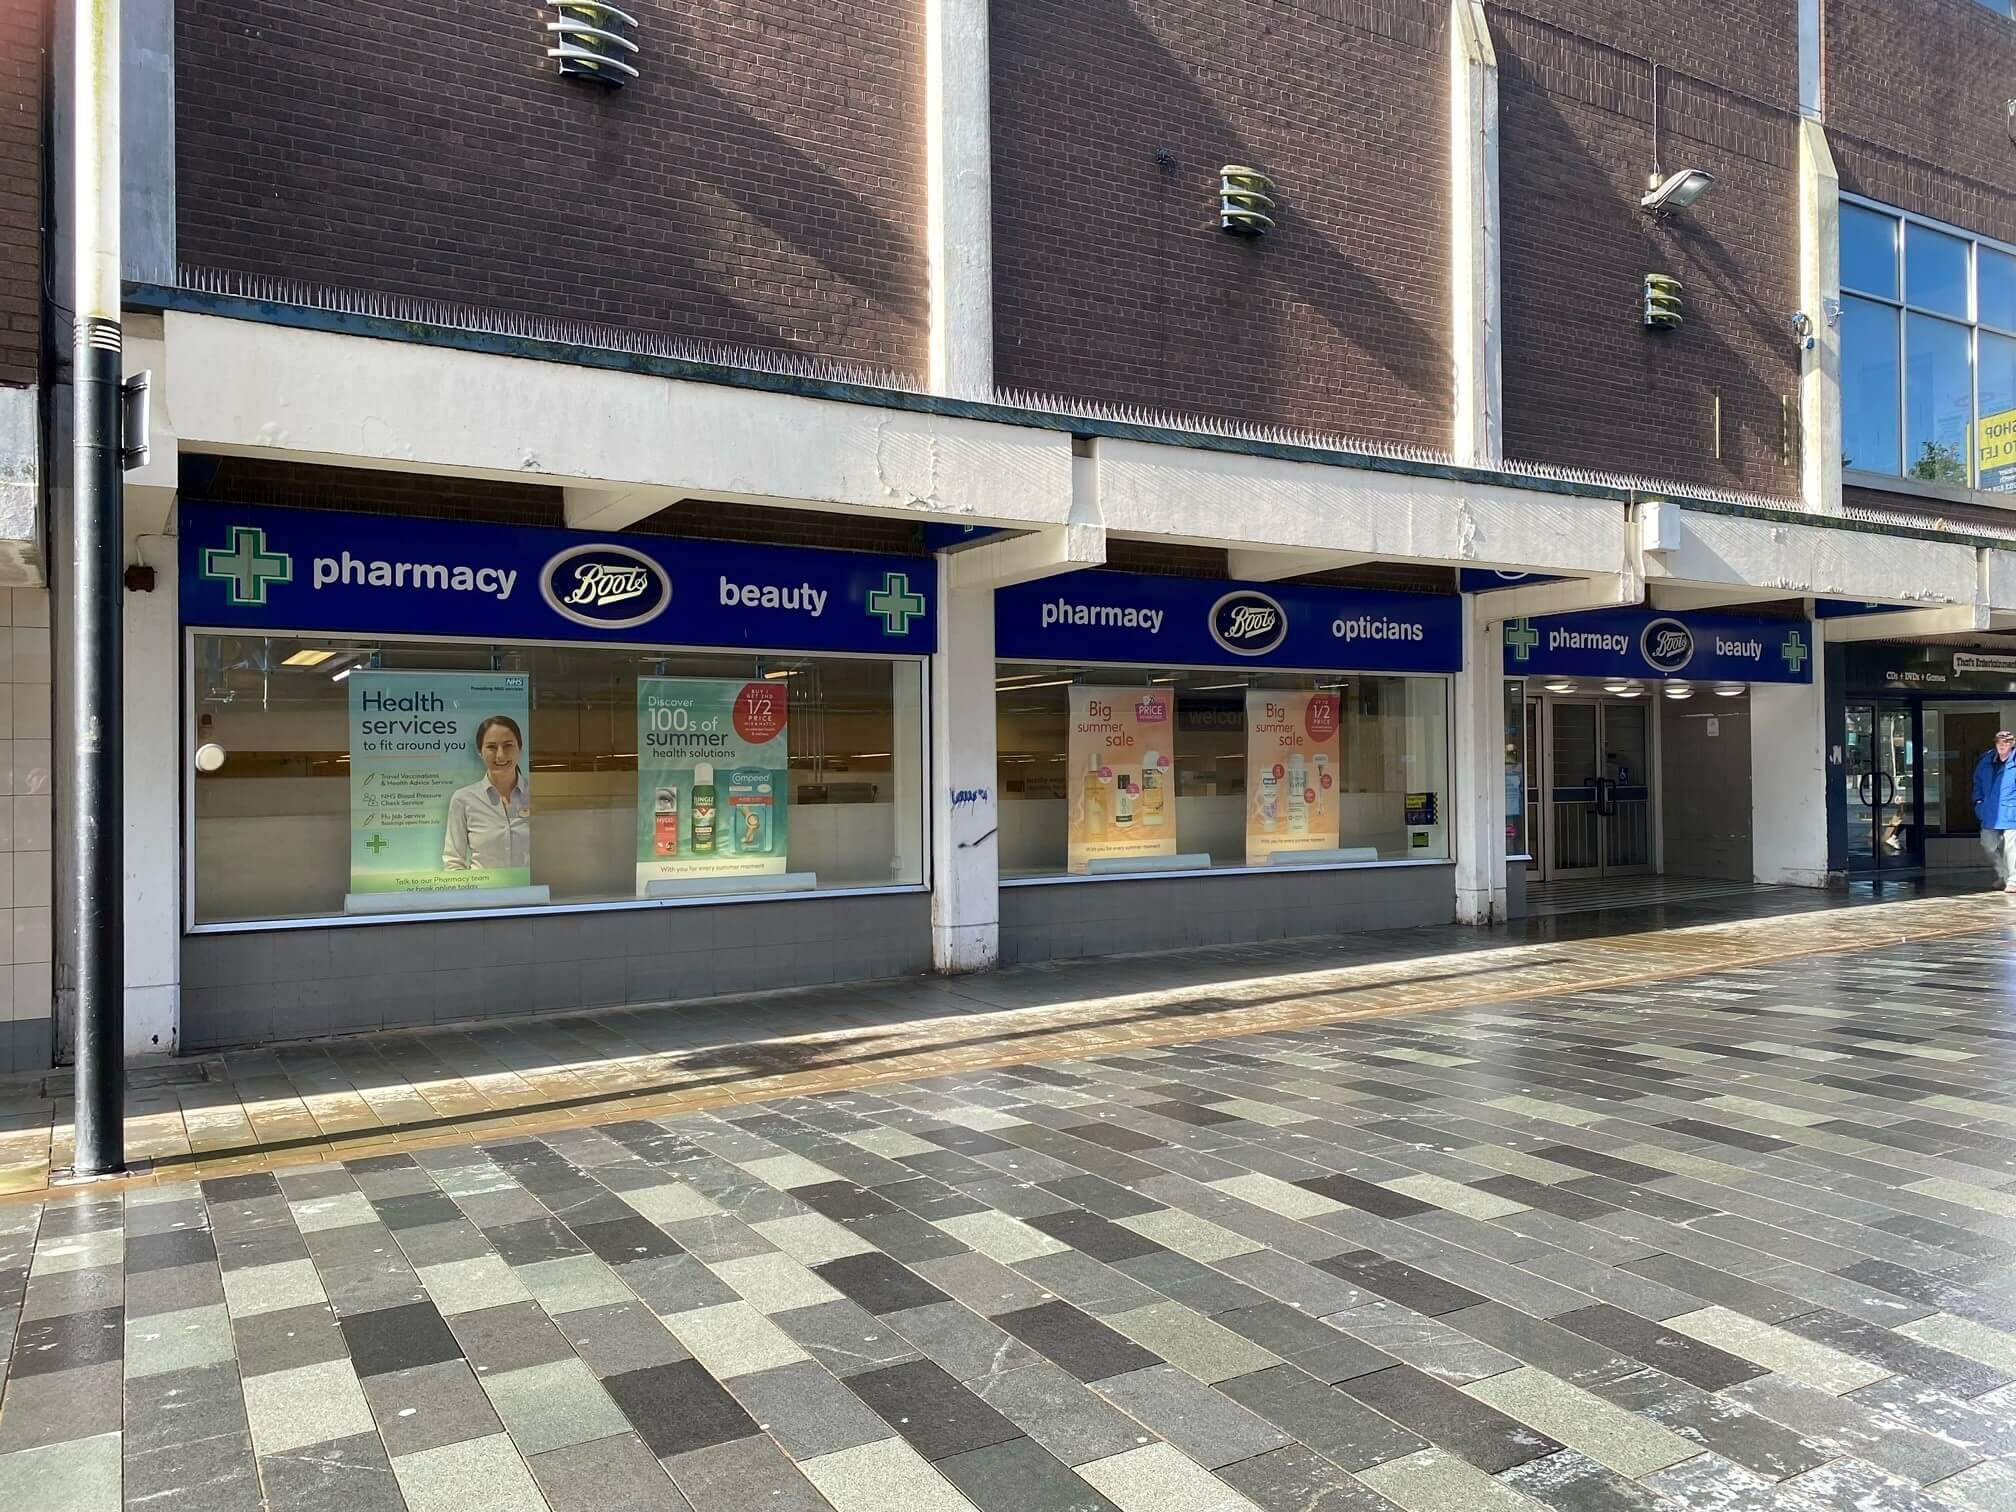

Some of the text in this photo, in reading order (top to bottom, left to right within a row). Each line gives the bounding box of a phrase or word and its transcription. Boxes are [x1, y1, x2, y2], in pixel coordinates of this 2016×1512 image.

[312, 551, 517, 600] pharmacy
[563, 562, 648, 607] Boots
[719, 575, 828, 617] beauty
[1041, 597, 1163, 634] pharmacy
[1224, 605, 1276, 640] Boots
[1331, 615, 1424, 642] opticians
[1549, 627, 1629, 655] pharmacy
[1652, 630, 1689, 658] Boots
[1715, 636, 1763, 662] beauty
[506, 678, 523, 686] NHS
[362, 690, 444, 712] Health
[648, 695, 694, 708] Discover
[747, 699, 772, 715] 1/2
[1089, 700, 1112, 722] Big
[1138, 705, 1163, 715] PRICE
[1313, 704, 1331, 719] 1/2
[647, 707, 719, 732] 100s of
[1266, 702, 1285, 723] Big
[361, 714, 457, 735] services
[1077, 722, 1124, 733] summer
[1255, 723, 1295, 734] summer
[363, 739, 466, 753] to fit around you
[646, 732, 729, 747] summer
[1105, 731, 1134, 747] sale
[1279, 731, 1304, 747] sale
[652, 747, 736, 758] health solutions
